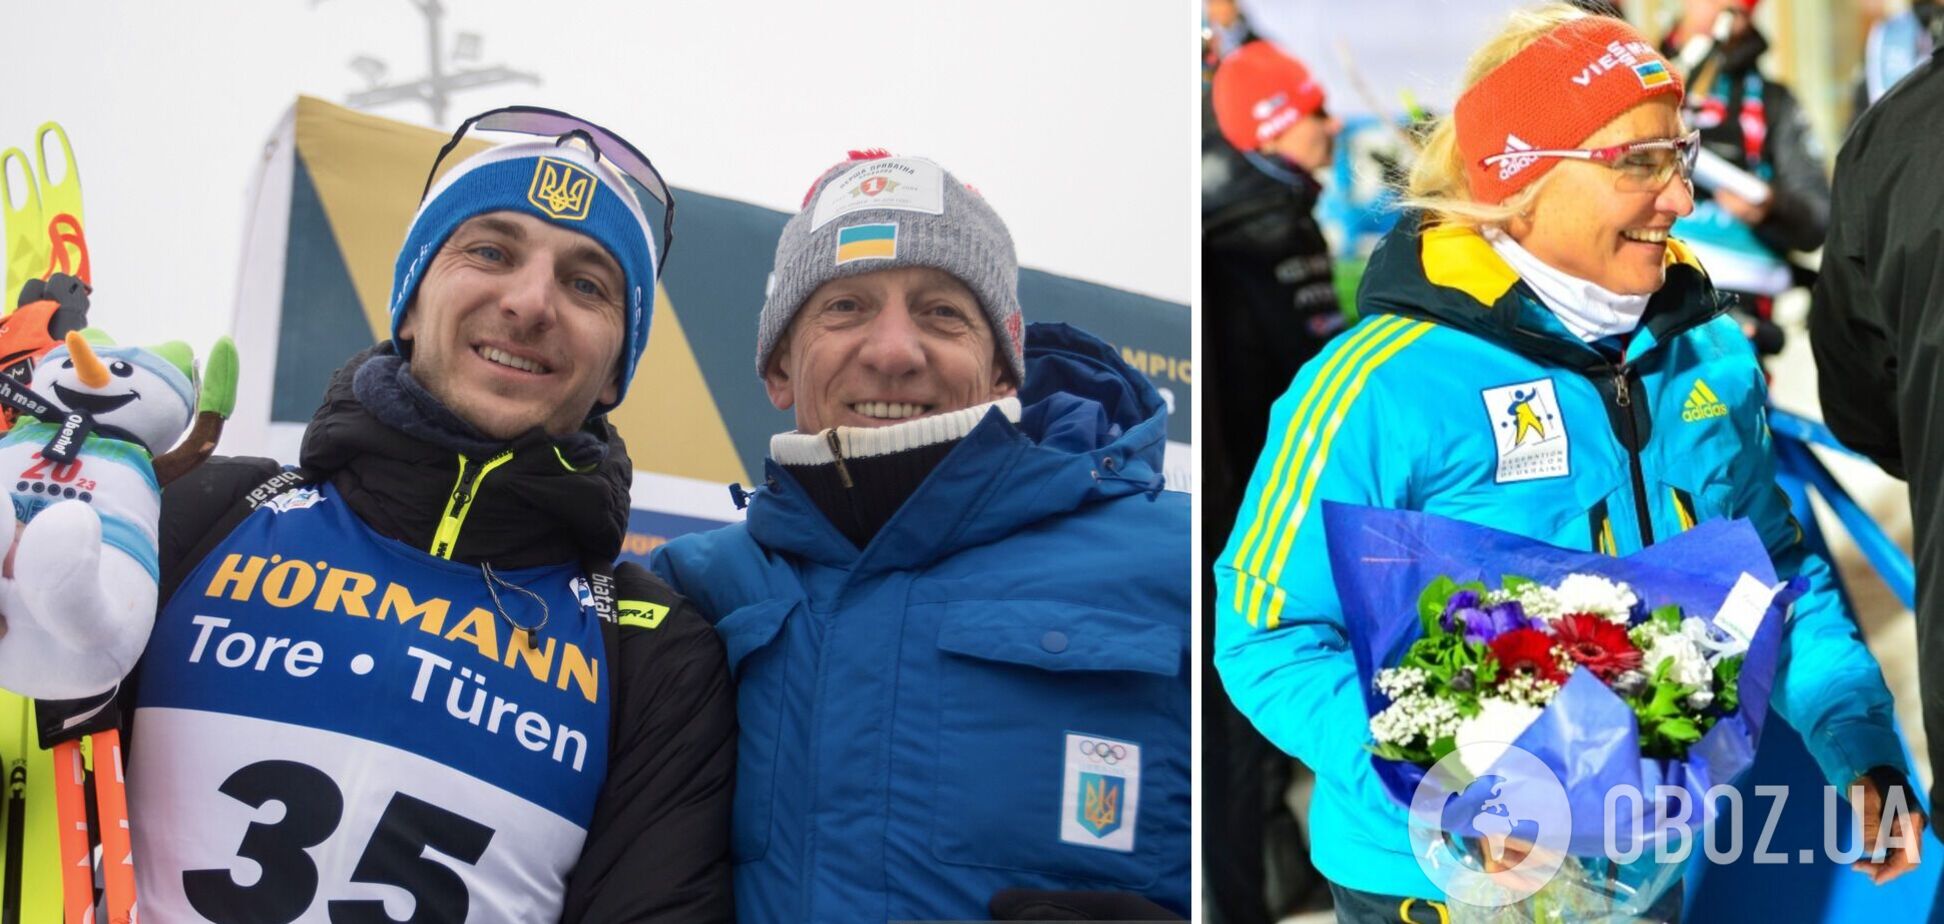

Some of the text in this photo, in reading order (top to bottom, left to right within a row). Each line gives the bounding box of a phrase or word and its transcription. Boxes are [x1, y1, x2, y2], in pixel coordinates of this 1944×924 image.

[866, 178, 879, 192] 1
[12, 393, 48, 414] mag
[1682, 403, 1727, 422] adidas
[52, 414, 83, 456] Oberhof
[245, 471, 304, 508] biatar
[592, 573, 616, 623] biatar
[205, 553, 598, 704] HÖRMANN
[189, 615, 588, 772] Tore Türen
[182, 759, 496, 924] 35
